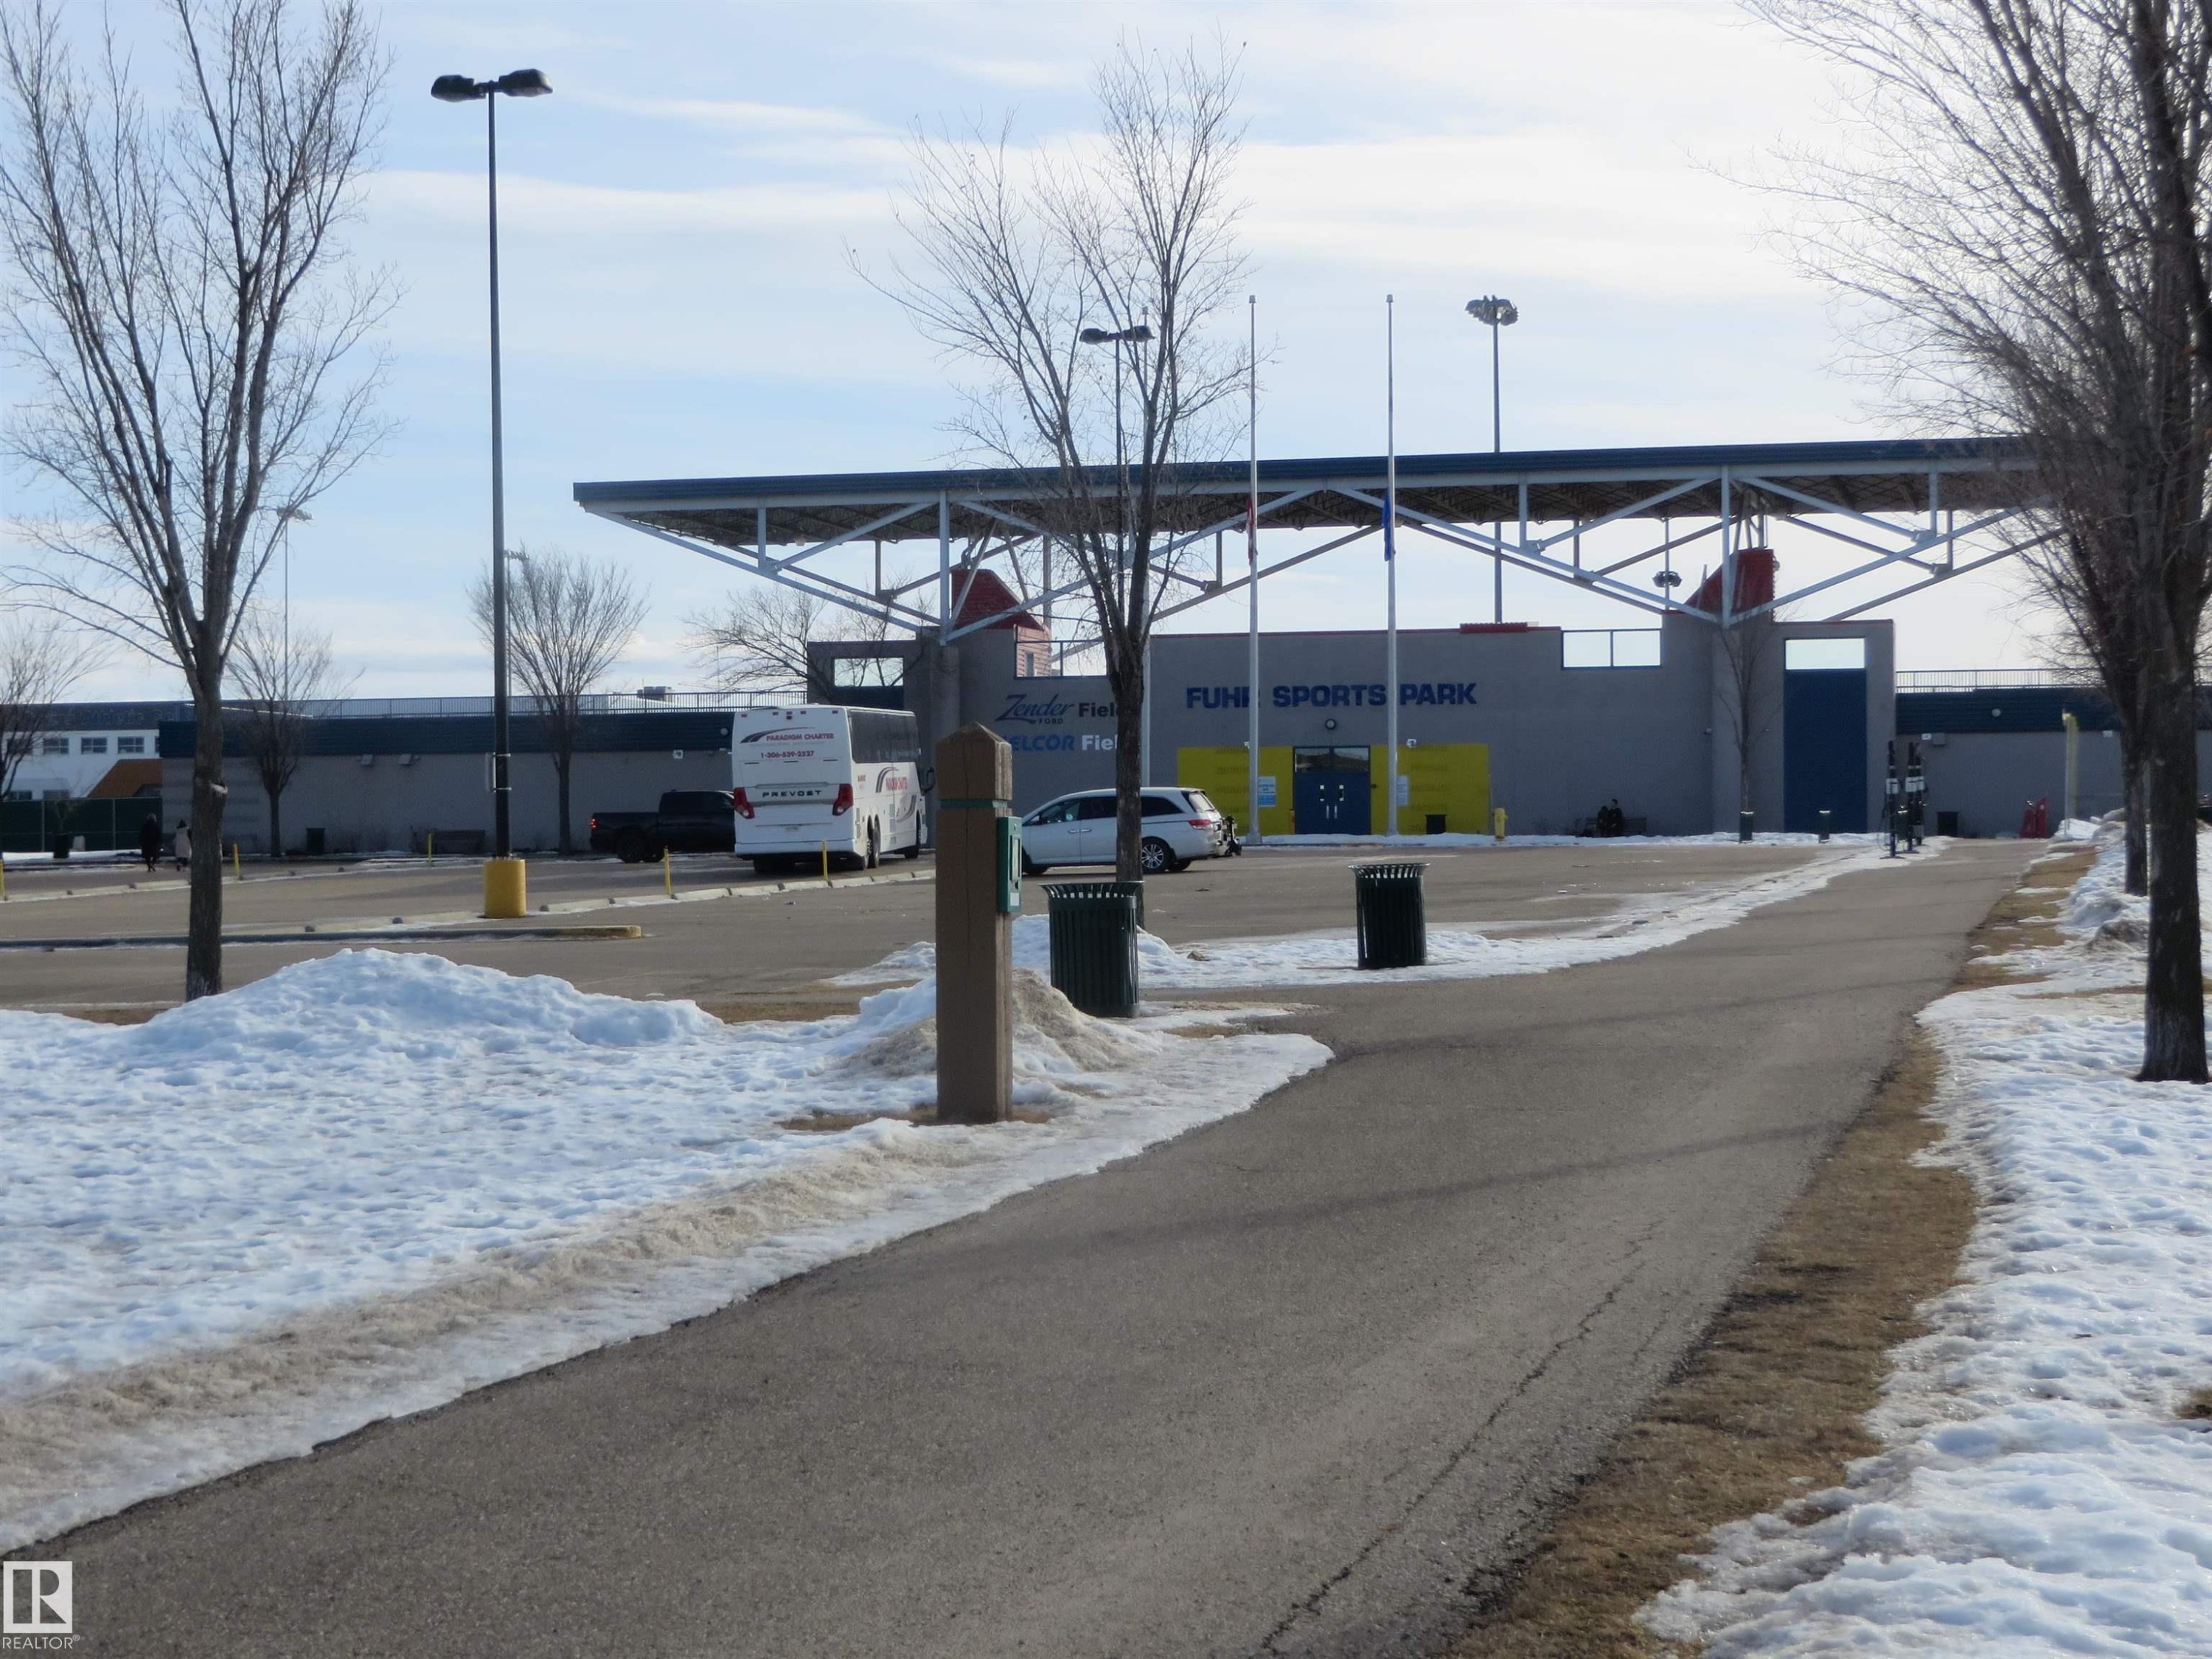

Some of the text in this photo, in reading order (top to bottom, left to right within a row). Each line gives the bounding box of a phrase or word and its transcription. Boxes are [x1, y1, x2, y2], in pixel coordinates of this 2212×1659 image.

[1273, 684, 1387, 708] SPORTS
[1399, 683, 1477, 705] PARK
[995, 693, 1119, 724] Zender Fiel
[804, 732, 835, 740] CHARTER
[1006, 734, 1118, 751] ELCOR Fiel
[762, 790, 822, 798] PREVOST
